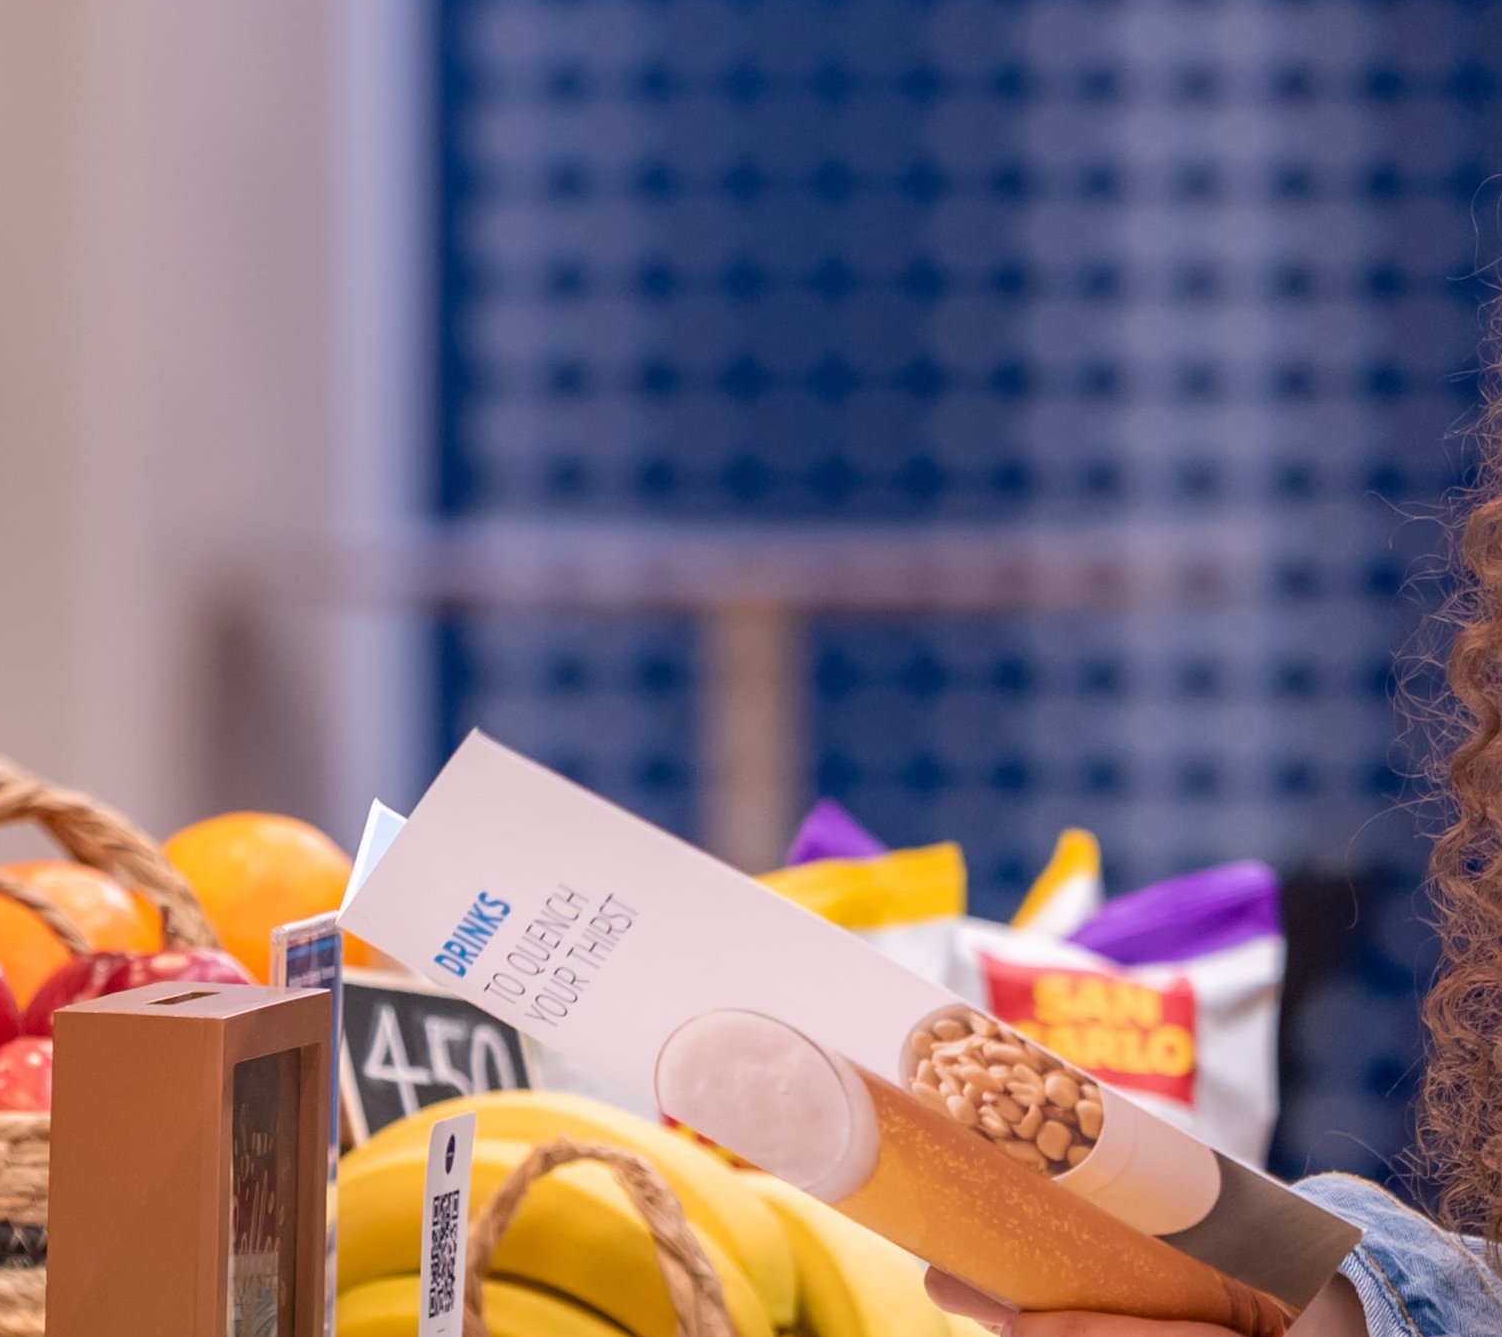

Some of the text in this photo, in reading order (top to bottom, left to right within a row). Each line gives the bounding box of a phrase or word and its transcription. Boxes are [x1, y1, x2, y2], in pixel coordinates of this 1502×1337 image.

[433, 891, 511, 978] DRINKS
[483, 883, 590, 1004] TO QUENCH
[524, 893, 639, 1027] YOUR THIRST
[1031, 970, 1161, 1029] SAN
